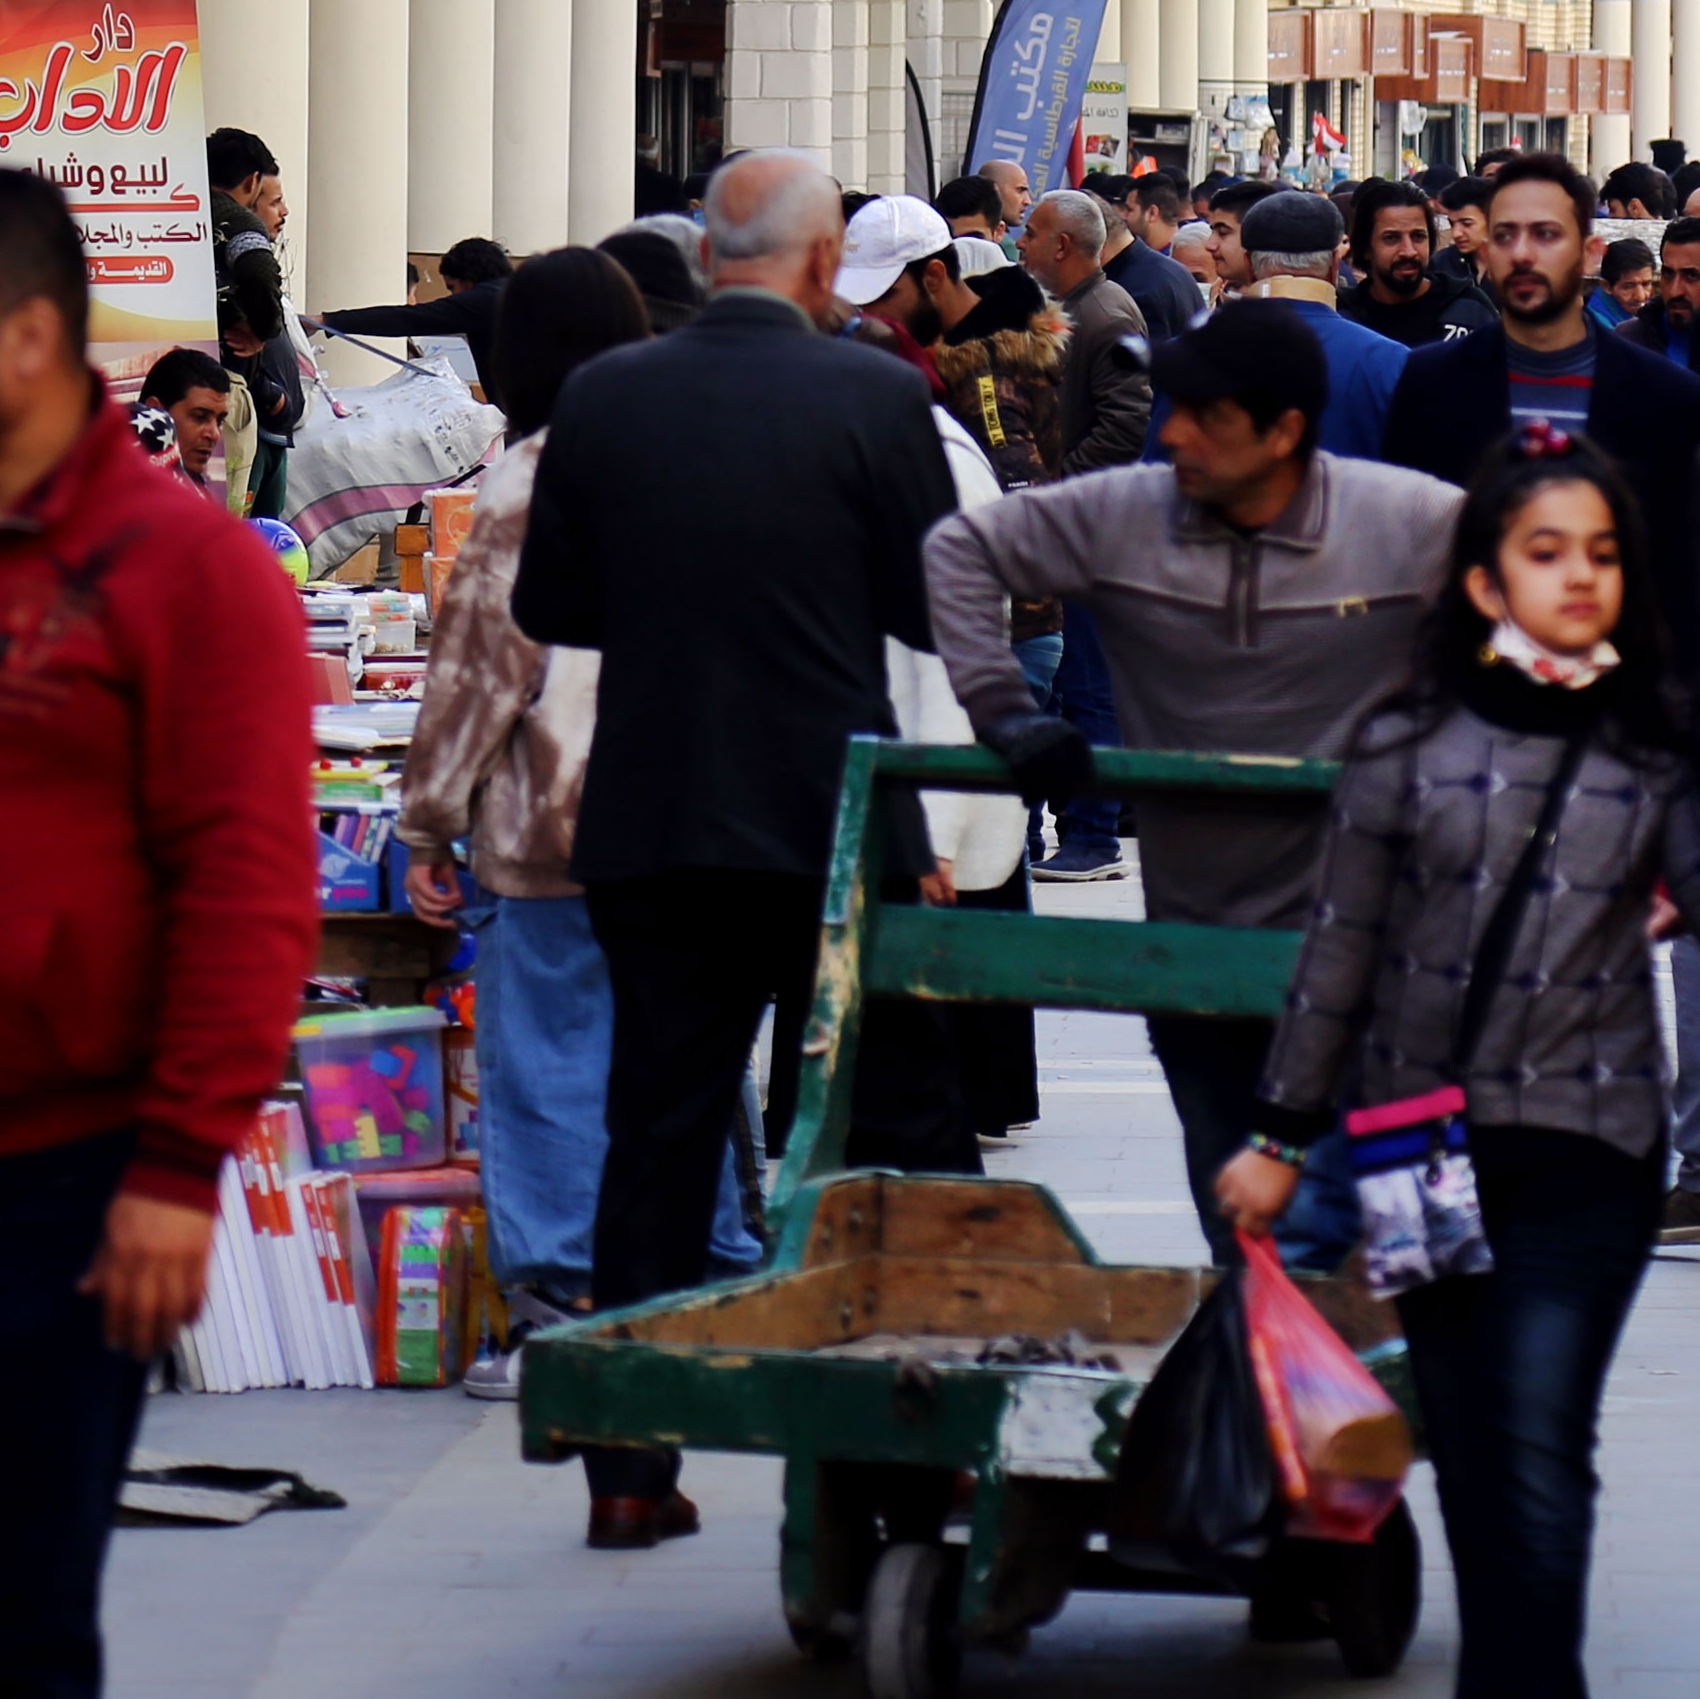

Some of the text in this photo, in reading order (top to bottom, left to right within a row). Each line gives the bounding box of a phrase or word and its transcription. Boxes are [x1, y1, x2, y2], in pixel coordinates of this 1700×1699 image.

[82, 3, 135, 62] دار
[1011, 12, 1054, 120] مكتب
[110, 156, 168, 195] لبيع
[76, 223, 207, 249] الكتب والمجلا
[99, 261, 168, 280] القديمة
